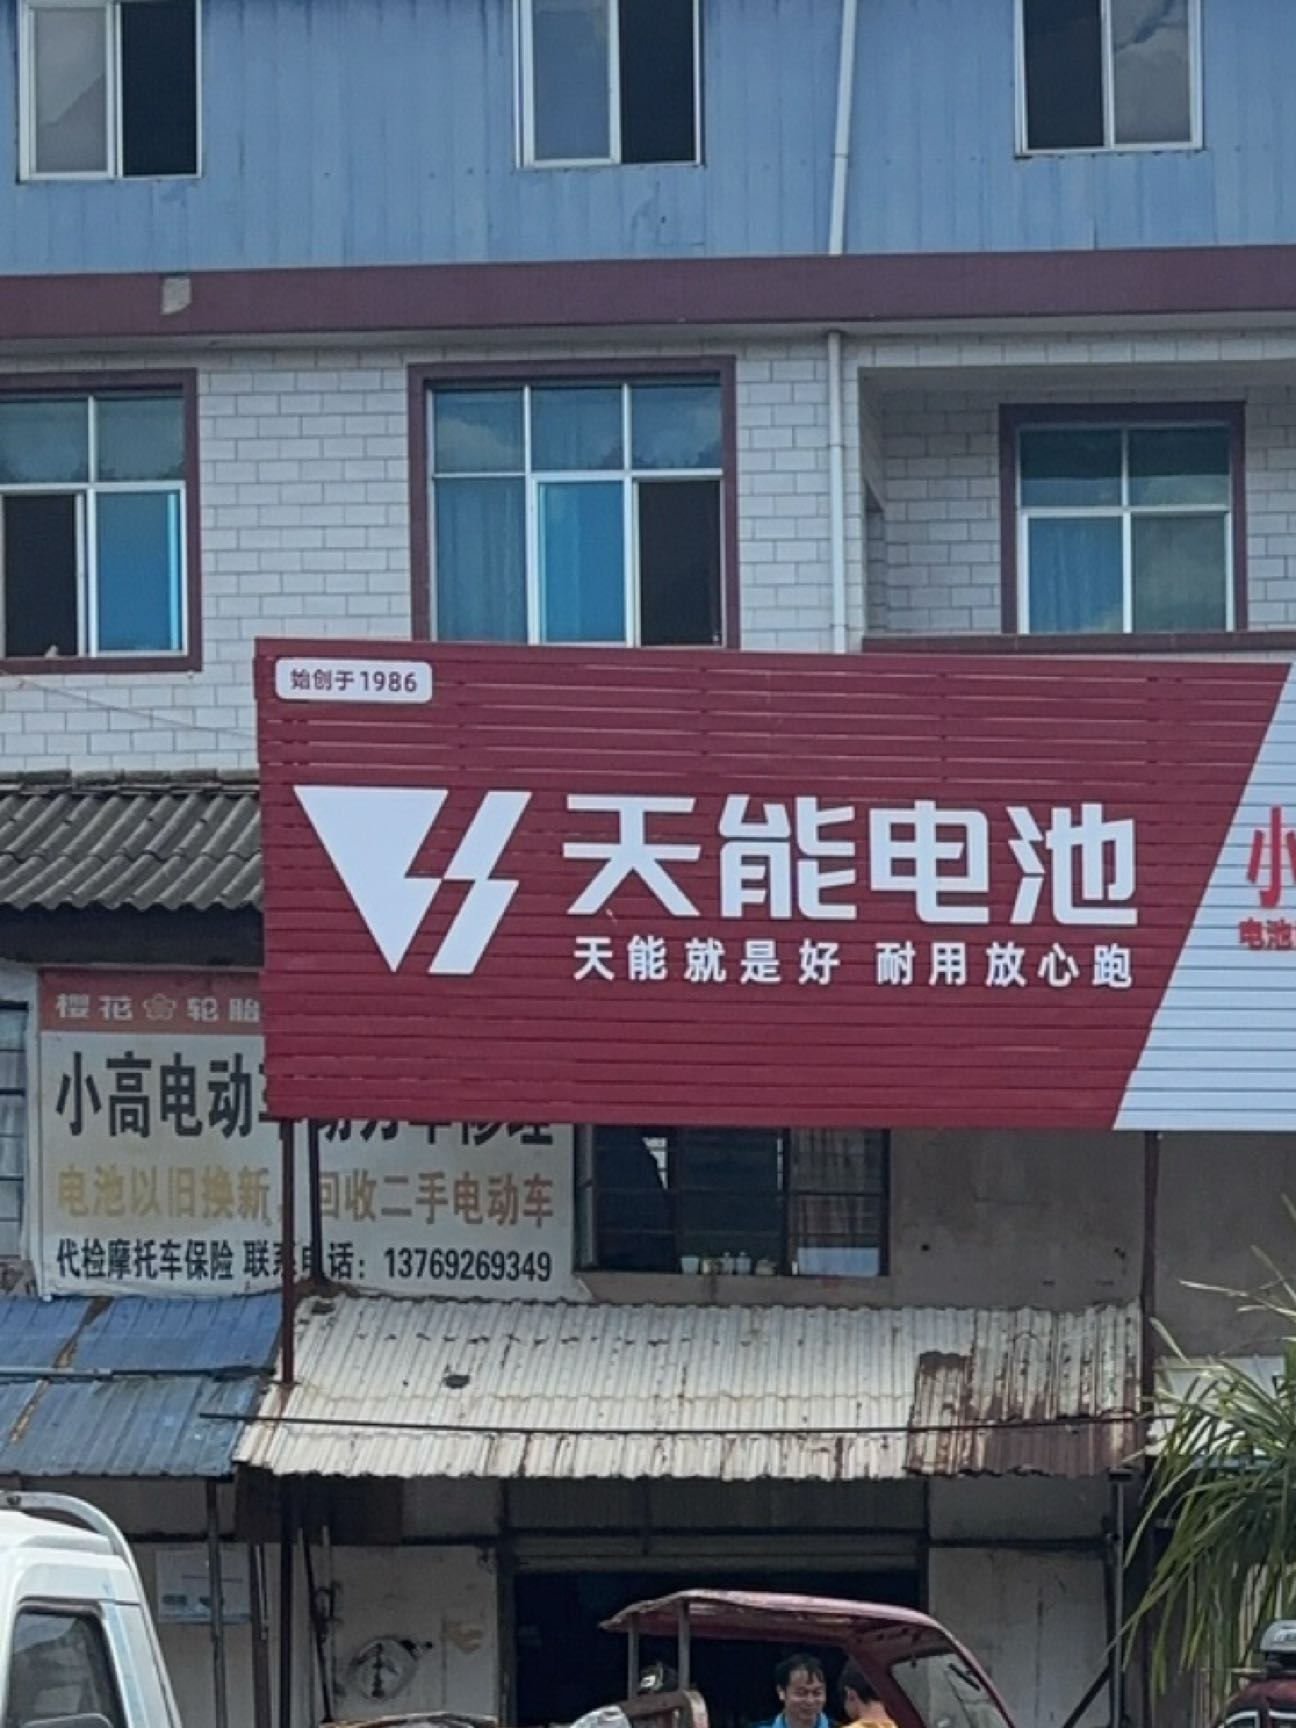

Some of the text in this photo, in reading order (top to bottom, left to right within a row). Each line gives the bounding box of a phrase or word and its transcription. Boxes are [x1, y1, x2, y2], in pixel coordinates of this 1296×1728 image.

[562, 794, 1138, 925] 天能电池
[573, 935, 1133, 988] 天能就是好 耐用放心跑
